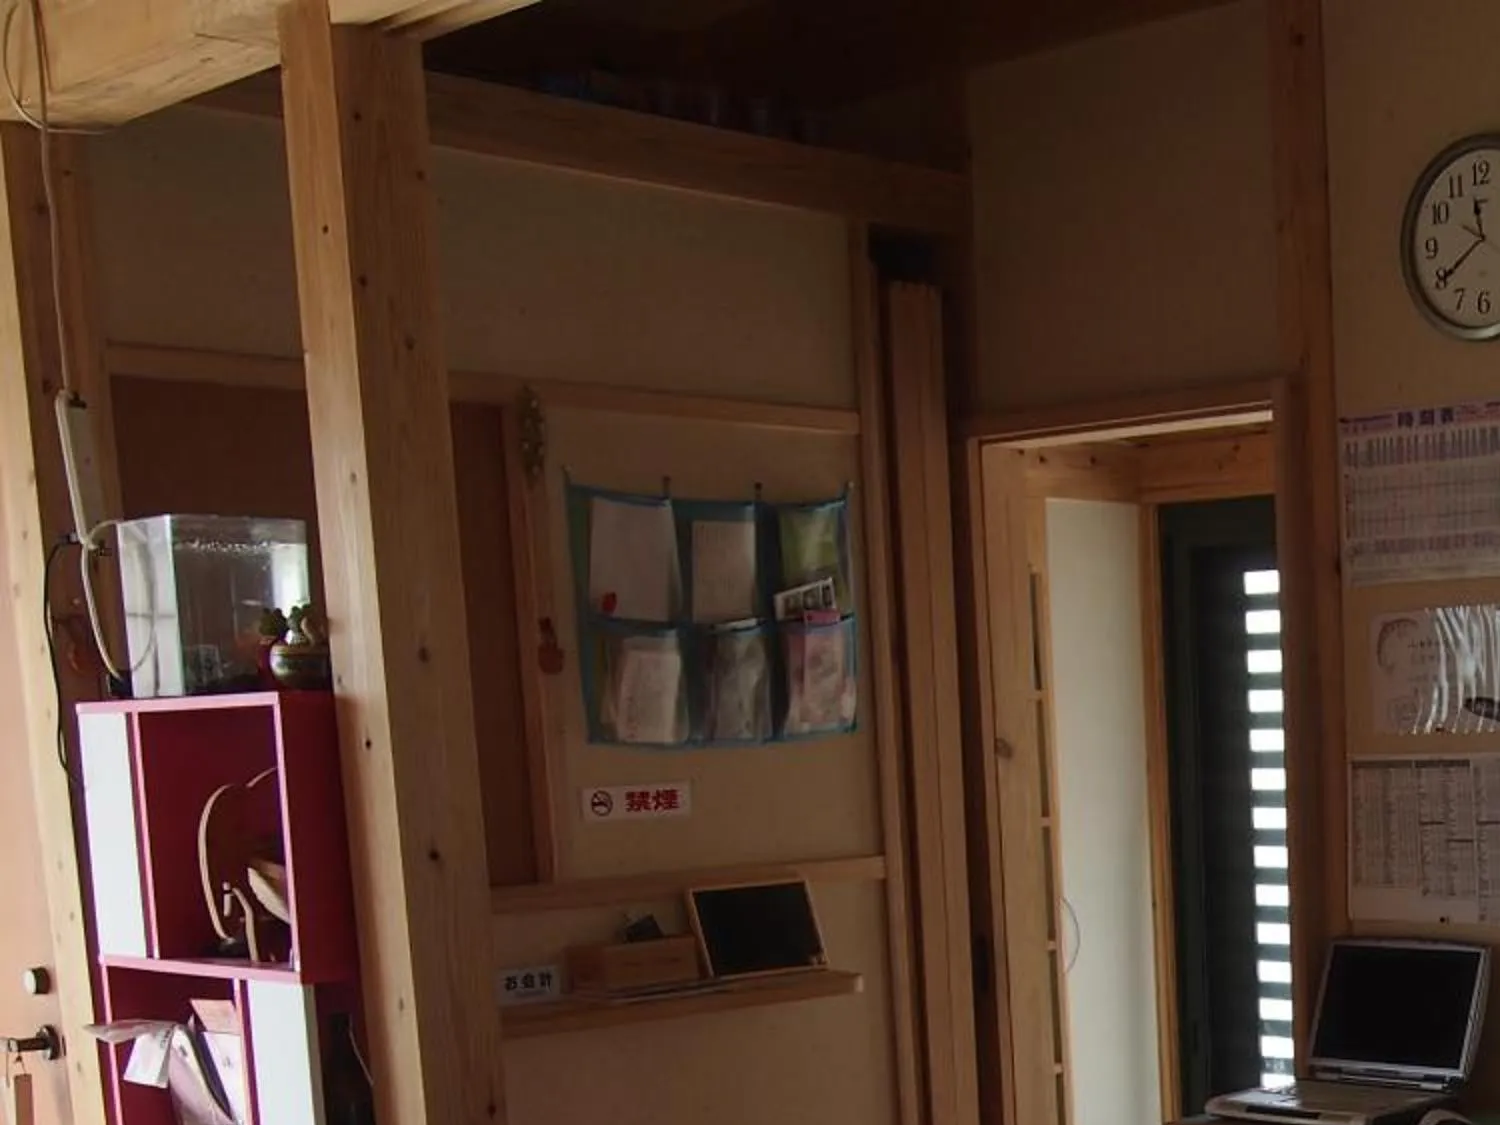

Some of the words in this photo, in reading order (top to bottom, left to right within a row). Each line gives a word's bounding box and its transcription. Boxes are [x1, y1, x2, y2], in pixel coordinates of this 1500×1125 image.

[1472, 160, 1490, 186] 12
[1449, 175, 1463, 199] 11
[1431, 202, 1449, 226] 10
[1425, 237, 1439, 260] 9
[1435, 267, 1448, 290] 8
[1454, 288, 1466, 312] 7
[1477, 290, 1491, 314] 6
[625, 789, 680, 812] 禁煙
